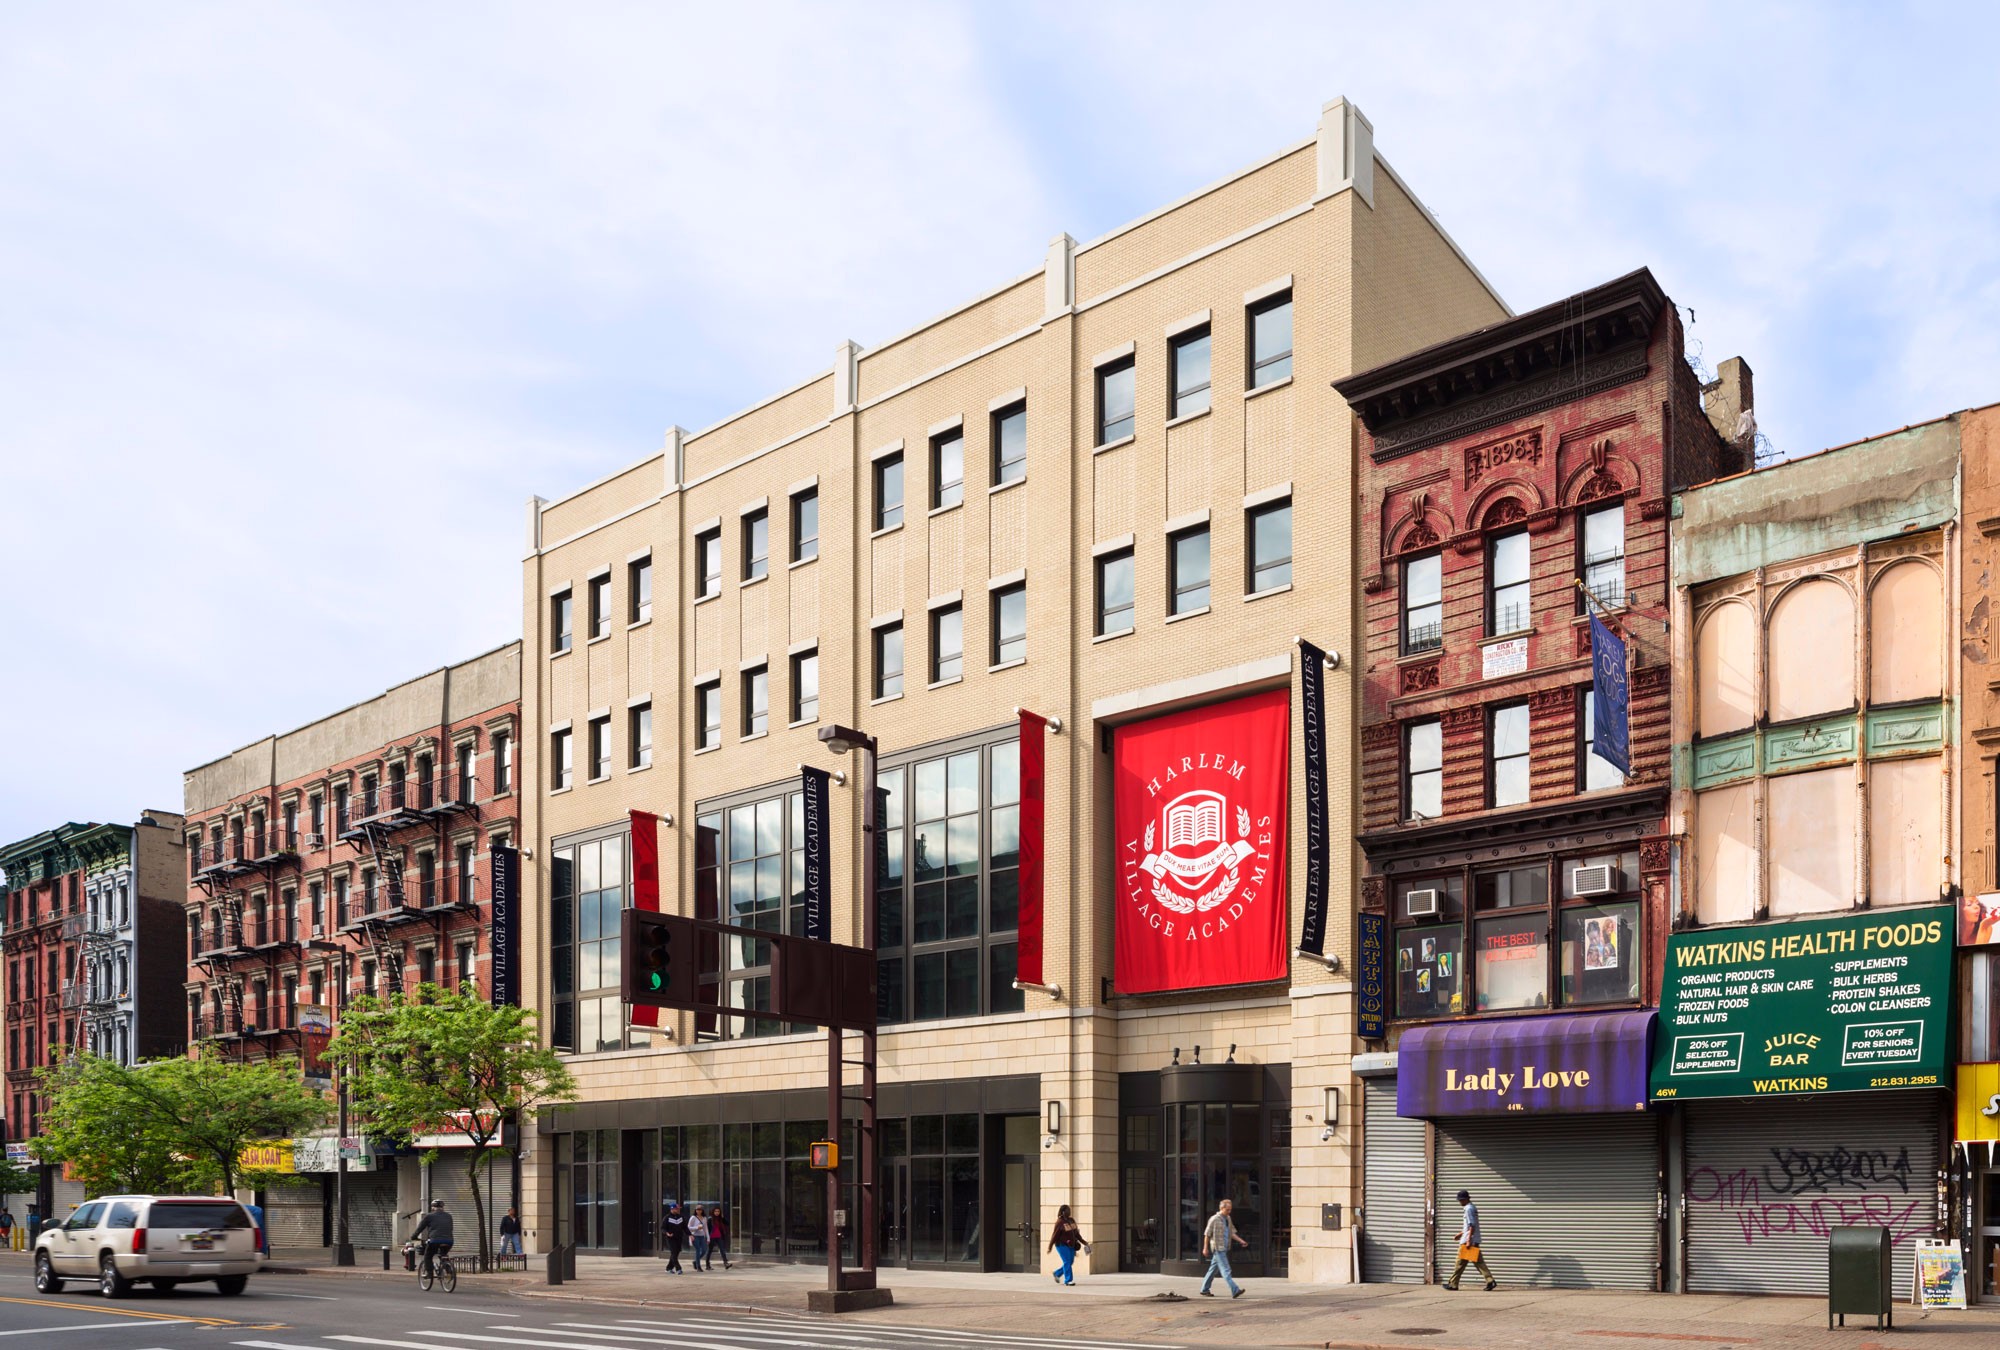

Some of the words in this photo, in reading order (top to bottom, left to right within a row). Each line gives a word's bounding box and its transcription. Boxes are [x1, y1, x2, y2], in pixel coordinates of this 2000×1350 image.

[1484, 438, 1526, 469] 1898
[1304, 653, 1320, 767] ACADEMIES
[1146, 753, 1246, 798] HARLEM
[807, 775, 819, 863] ACADEMIES
[1309, 770, 1320, 851] VILLAGE
[1164, 855, 1176, 865] DUX
[1198, 859, 1216, 870] VITAE
[1216, 847, 1229, 860] SUM
[1126, 838, 1174, 938] VILLAGE
[1186, 816, 1271, 941] ACADEMIES
[495, 852, 506, 926] ACADEMIES
[808, 865, 819, 931] VILLAGE
[1305, 859, 1320, 942] HARLEM
[1487, 935, 1508, 949] THE
[1509, 932, 1536, 946] BEST
[1675, 939, 1766, 968] WATKINS
[1770, 930, 1855, 959] HEALTH
[1863, 920, 1942, 950] FOODS
[495, 926, 506, 978] VILLAGE
[1361, 918, 1381, 1012] TATTOO
[1834, 956, 1908, 972] SUPPLEMENTS
[1681, 973, 1722, 985] ORGANIC
[1725, 969, 1775, 982] PRODUCTS
[1833, 975, 1861, 987] BULK
[1863, 972, 1898, 984] HERBS
[1680, 987, 1722, 999] NATURAL
[1725, 985, 1748, 996] HAIR
[1751, 983, 1759, 994] &
[1761, 982, 1785, 994] SKIN
[1787, 979, 1814, 991] CARE
[1832, 987, 1876, 1000] PROTEIN
[1878, 984, 1921, 997] SHAKES
[1678, 1000, 1715, 1012] FROZEN
[1718, 998, 1749, 1010] FOODS
[1831, 1001, 1867, 1014] COLON
[1869, 997, 1931, 1011] CLEANSERS
[1361, 1014, 1381, 1022] STUDIO
[1676, 1014, 1701, 1025] BULK
[1703, 1012, 1728, 1023] NUTS
[1366, 1023, 1376, 1031] 125
[1864, 1029, 1884, 1038] 10%
[1886, 1028, 1905, 1037] OFF
[1689, 1040, 1709, 1049] 20%
[1710, 1040, 1727, 1049] OFF
[1764, 1032, 1821, 1052] JUICE
[1852, 1040, 1870, 1049] FOR
[1871, 1038, 1914, 1048] SENIORS
[1686, 1050, 1729, 1059] SELECTED
[1770, 1053, 1809, 1067] BAR
[1846, 1050, 1876, 1059] EVERY
[1877, 1048, 1918, 1058] TUESDAY
[1675, 1059, 1736, 1069] SUPPLEMENTS
[1445, 1068, 1515, 1095] Lady
[1522, 1066, 1590, 1089] Love
[1753, 1077, 1828, 1093] WATKINS
[1871, 1075, 1937, 1087] 212.831.2955
[1656, 1088, 1677, 1097] 46W
[261, 1148, 281, 1165] LOAN
